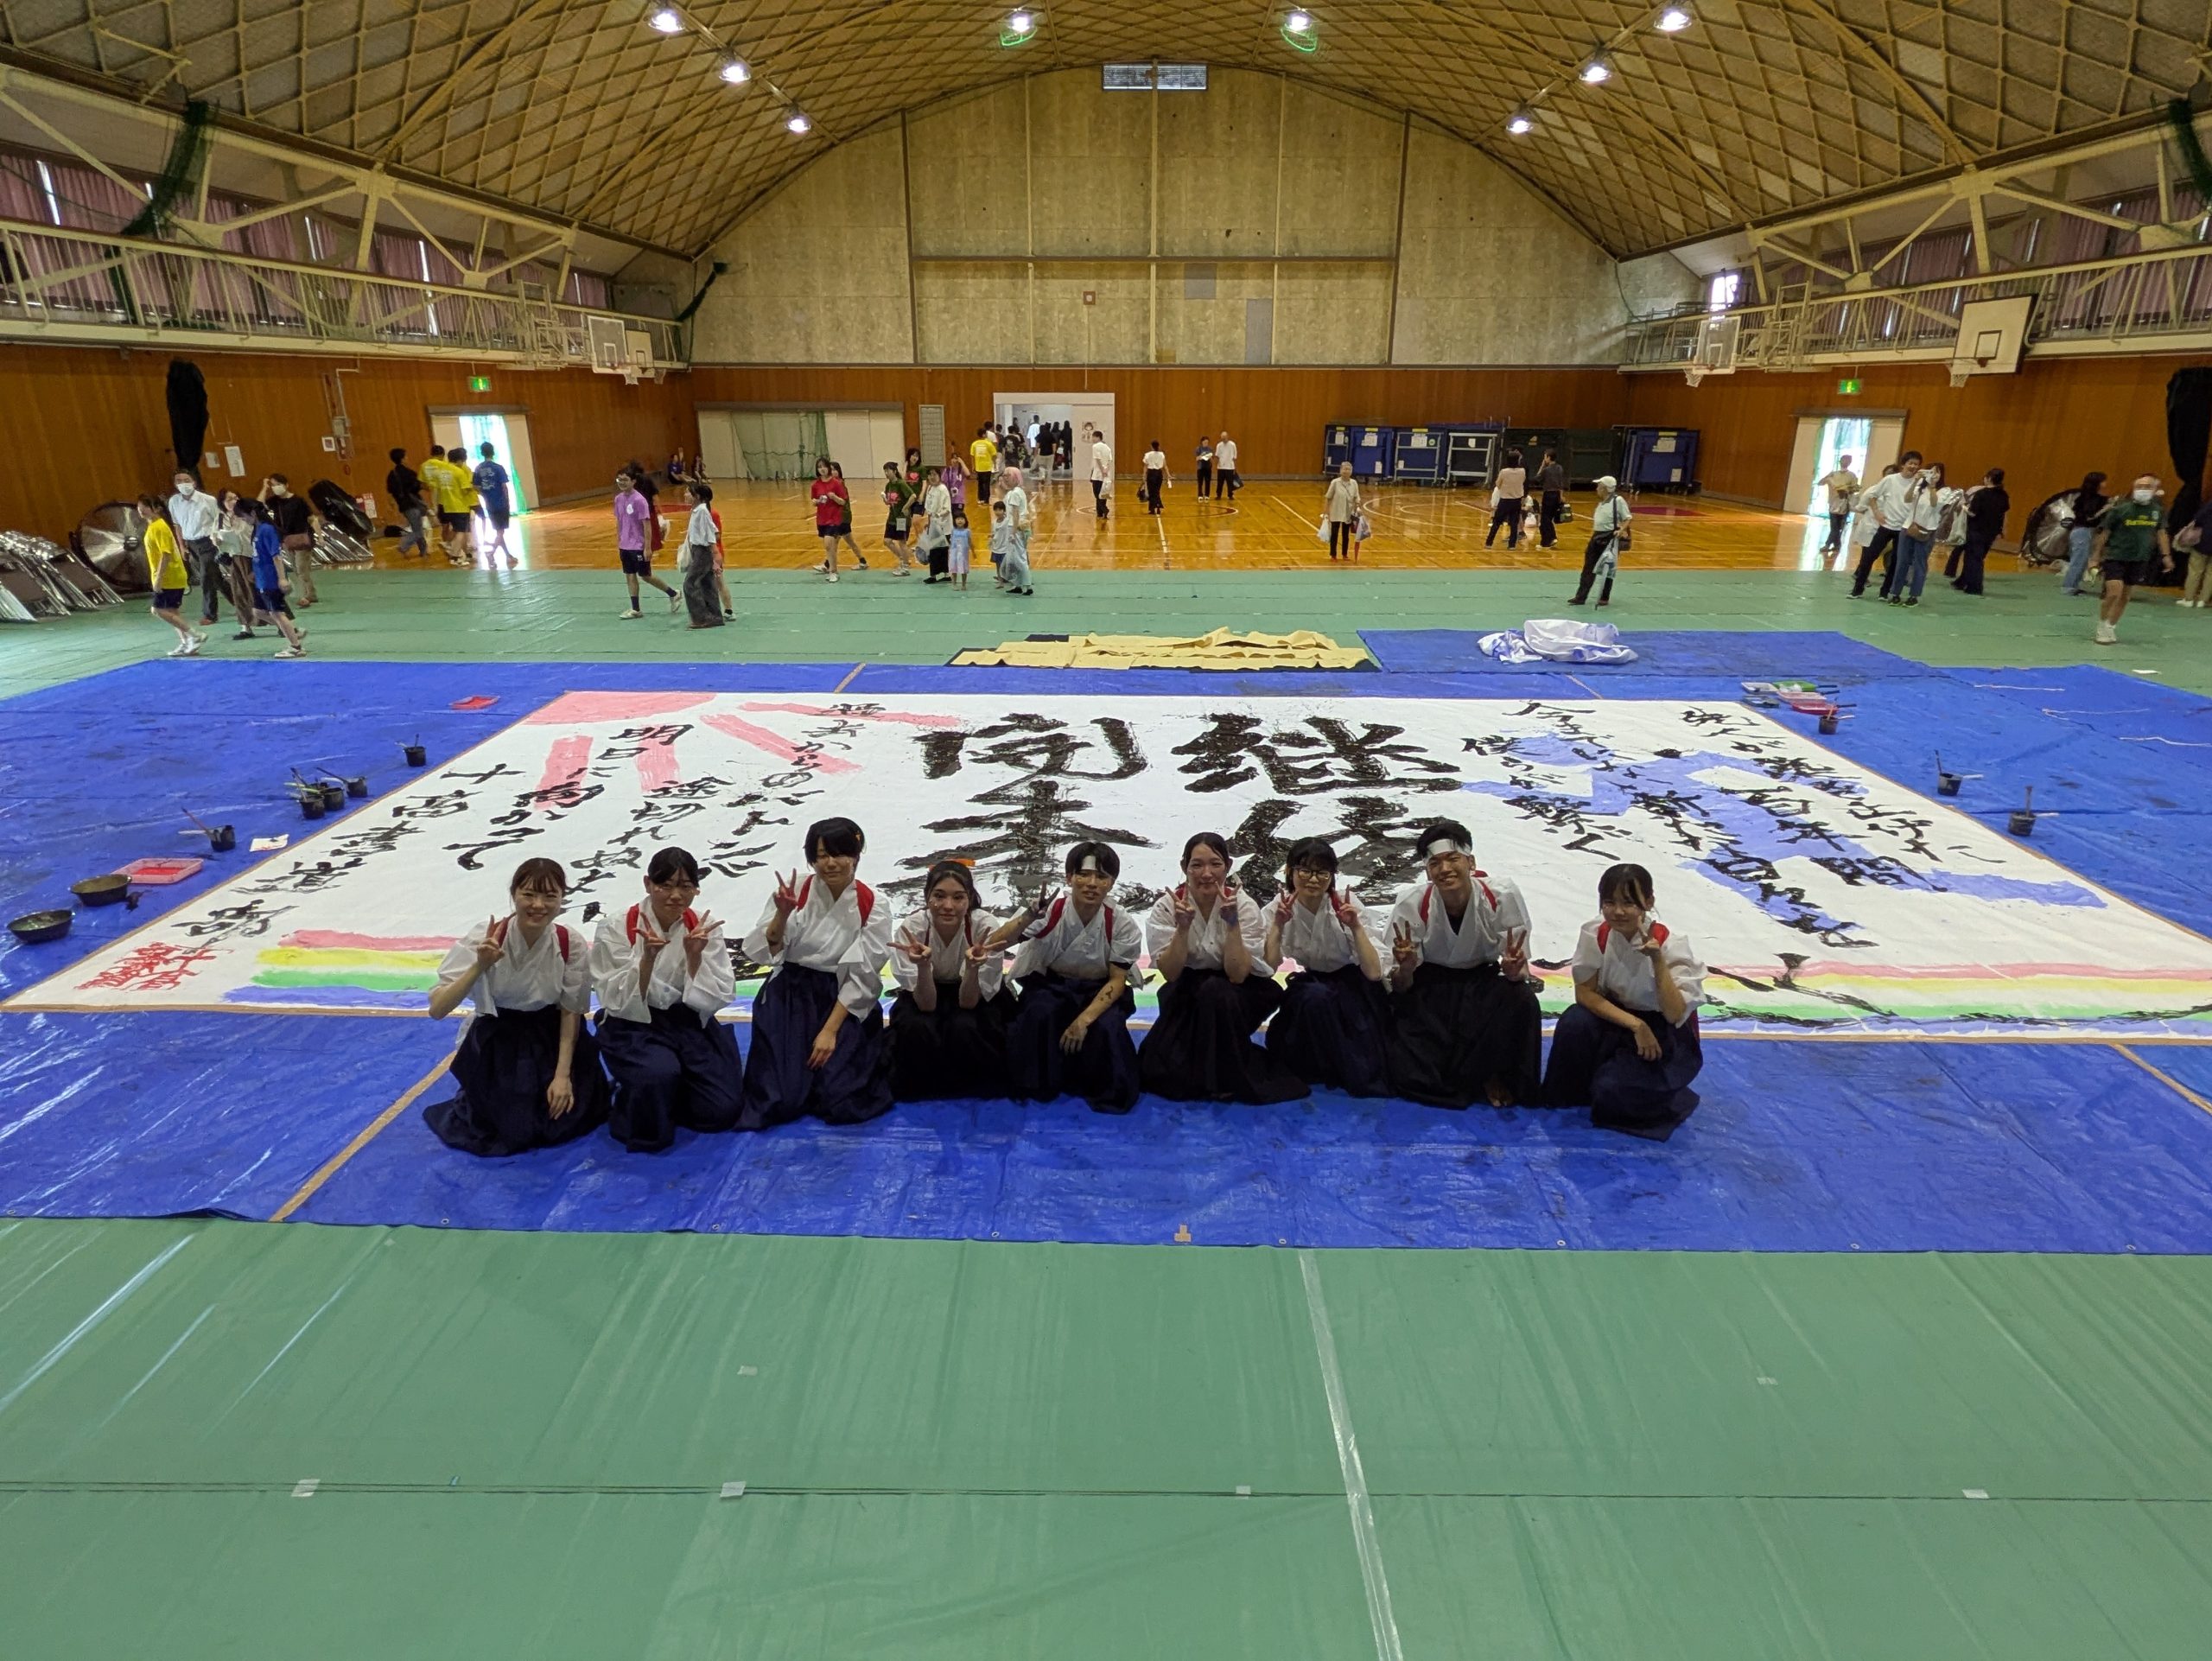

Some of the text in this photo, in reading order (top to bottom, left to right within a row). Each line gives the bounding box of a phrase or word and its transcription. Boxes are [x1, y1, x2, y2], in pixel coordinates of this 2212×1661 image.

[171, 764, 524, 948] 十高書道部
[442, 724, 695, 873] 明日に向かって
[1462, 735, 1631, 861] 僕らが繋ぐ
[1718, 786, 1948, 893] 百年間
